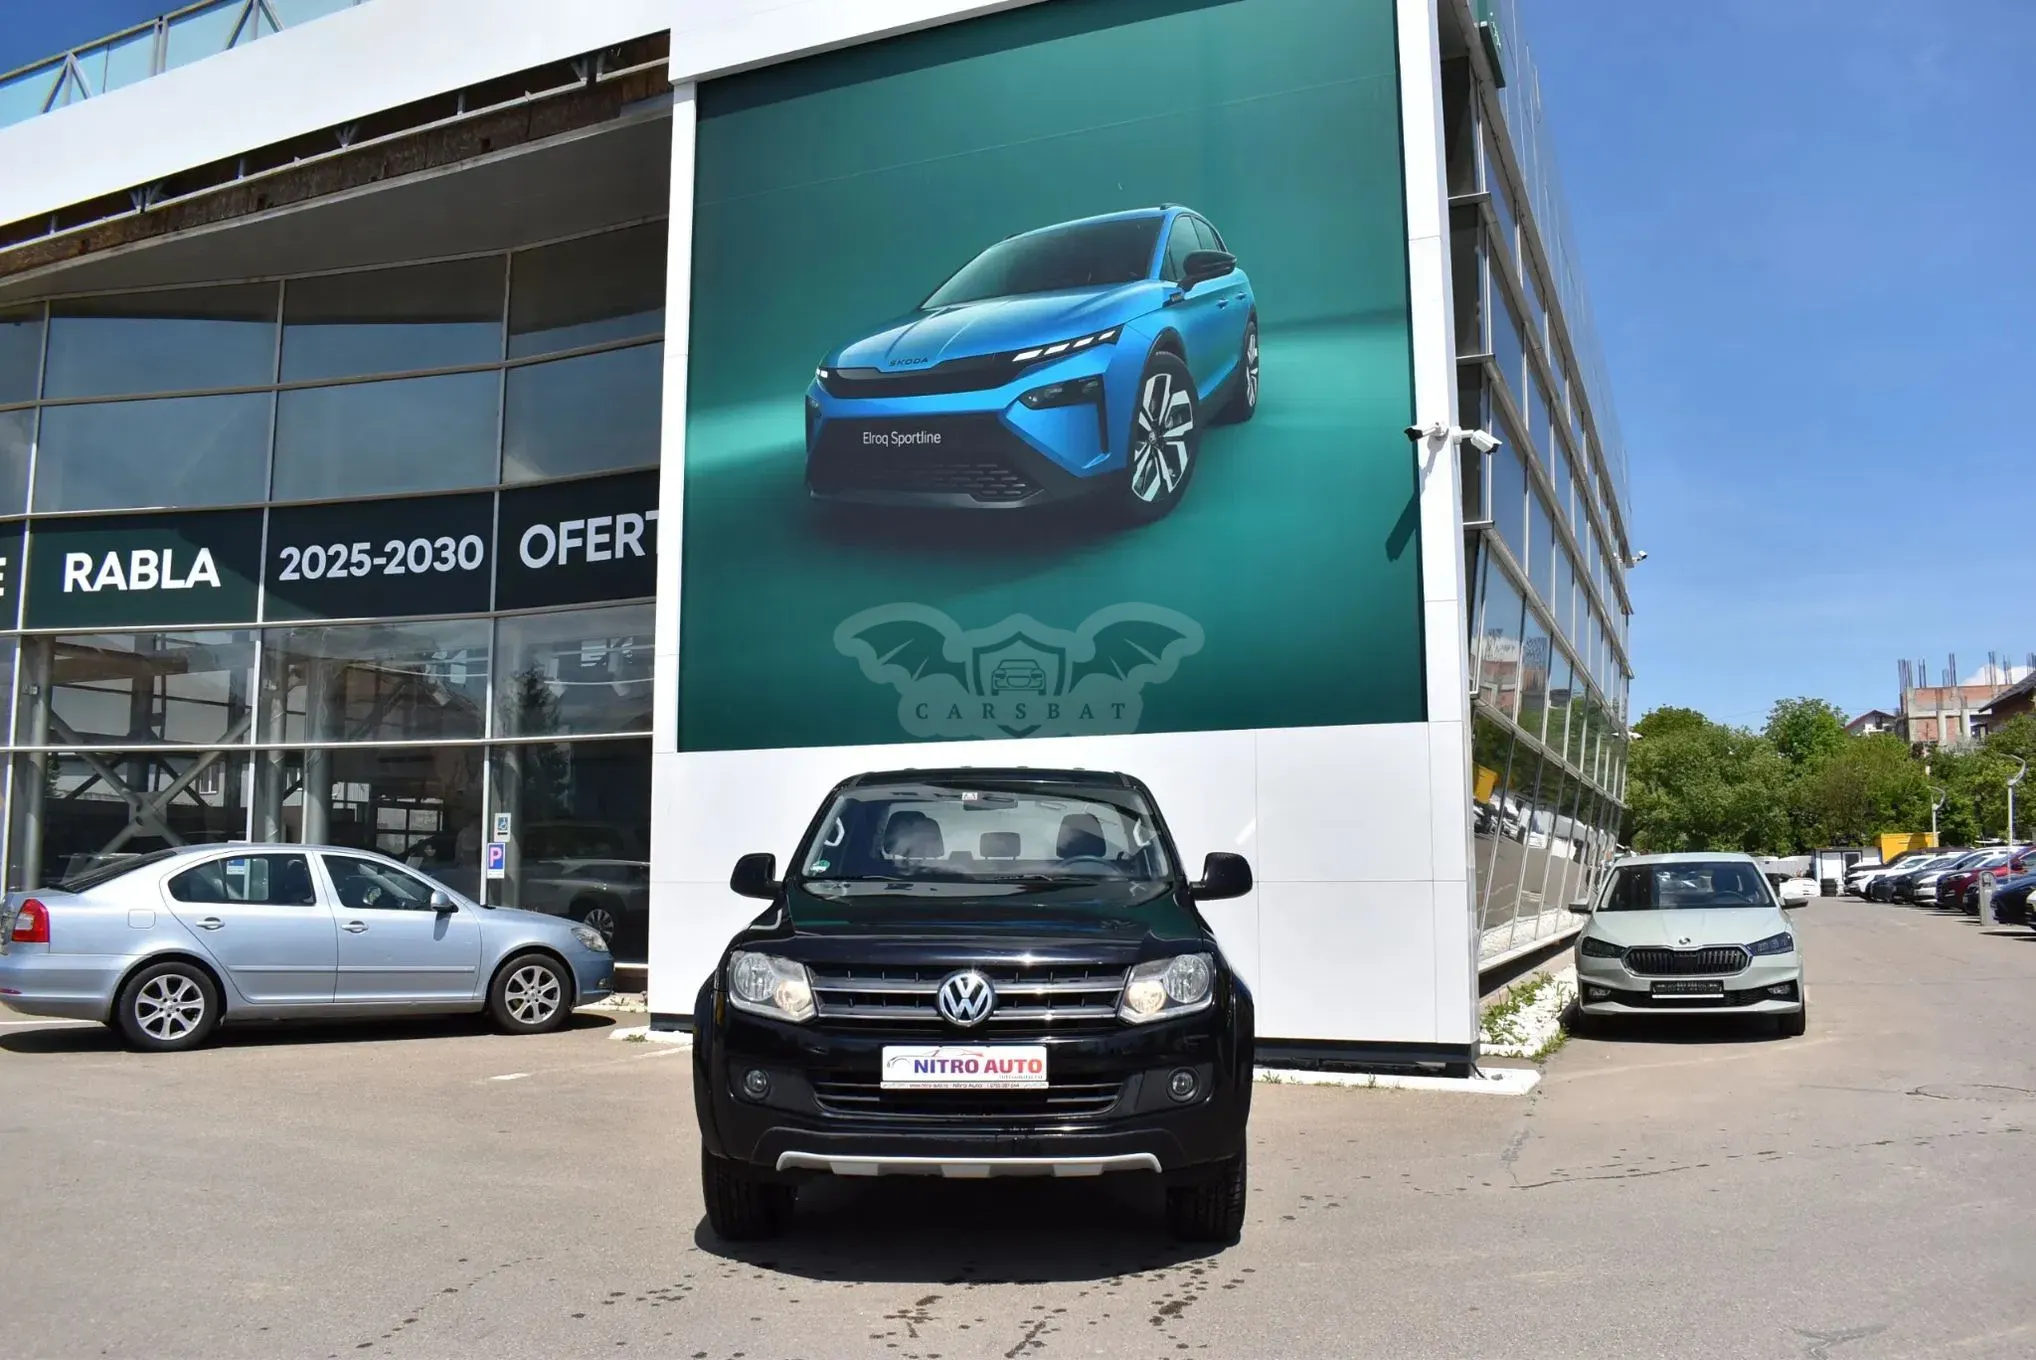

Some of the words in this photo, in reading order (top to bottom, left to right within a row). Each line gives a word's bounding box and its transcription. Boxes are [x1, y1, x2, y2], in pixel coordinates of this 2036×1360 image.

[863, 431, 889, 447] Elroq
[891, 430, 941, 447] Sportline
[63, 547, 221, 593] RABLA
[278, 535, 485, 581] 2025-2030
[490, 847, 502, 867] P
[914, 1059, 979, 1074] NITRO
[983, 1059, 1043, 1074] AUTO
